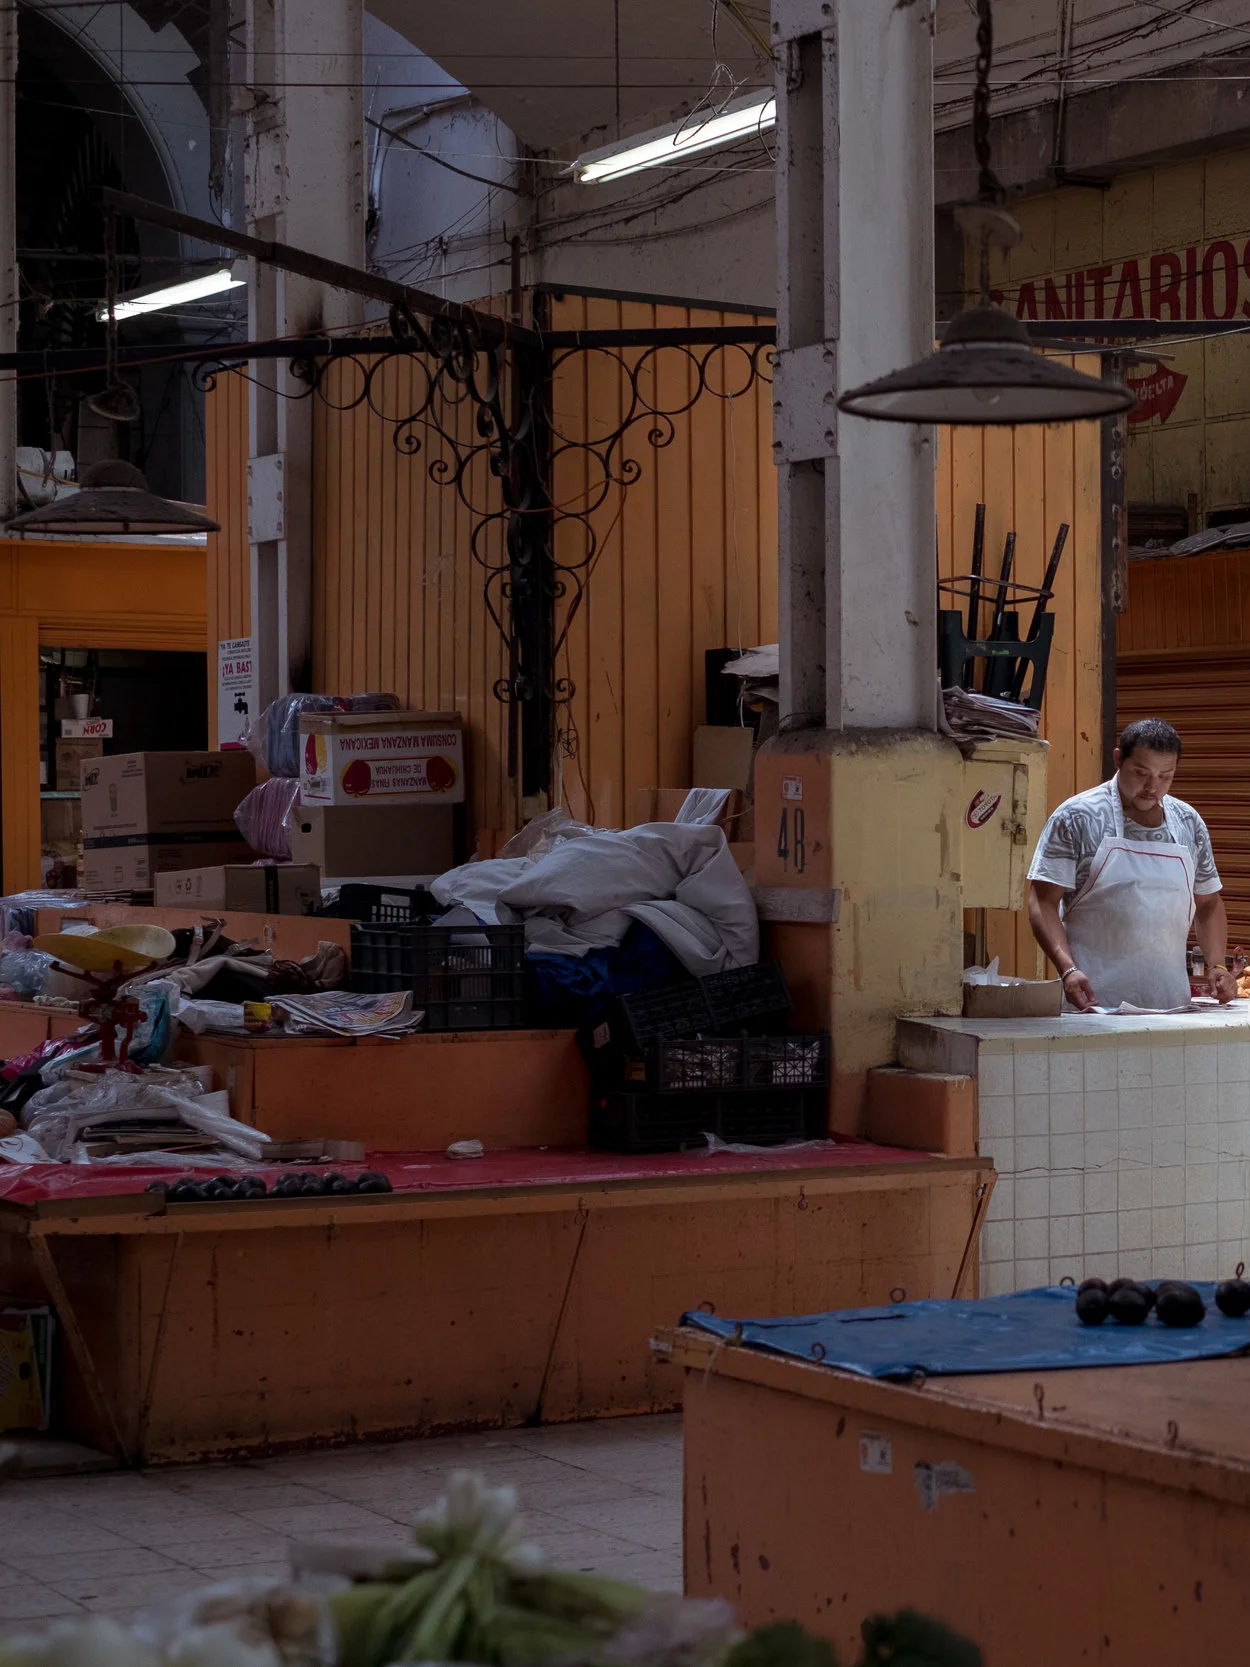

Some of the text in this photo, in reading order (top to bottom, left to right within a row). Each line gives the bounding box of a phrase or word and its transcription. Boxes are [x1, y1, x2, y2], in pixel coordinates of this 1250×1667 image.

[83, 722, 107, 735] CORN
[339, 734, 457, 750] CONSUMA MANZANA MEXICANA
[375, 763, 422, 775] DE CHIHUAHUA
[371, 778, 390, 788] FINAS
